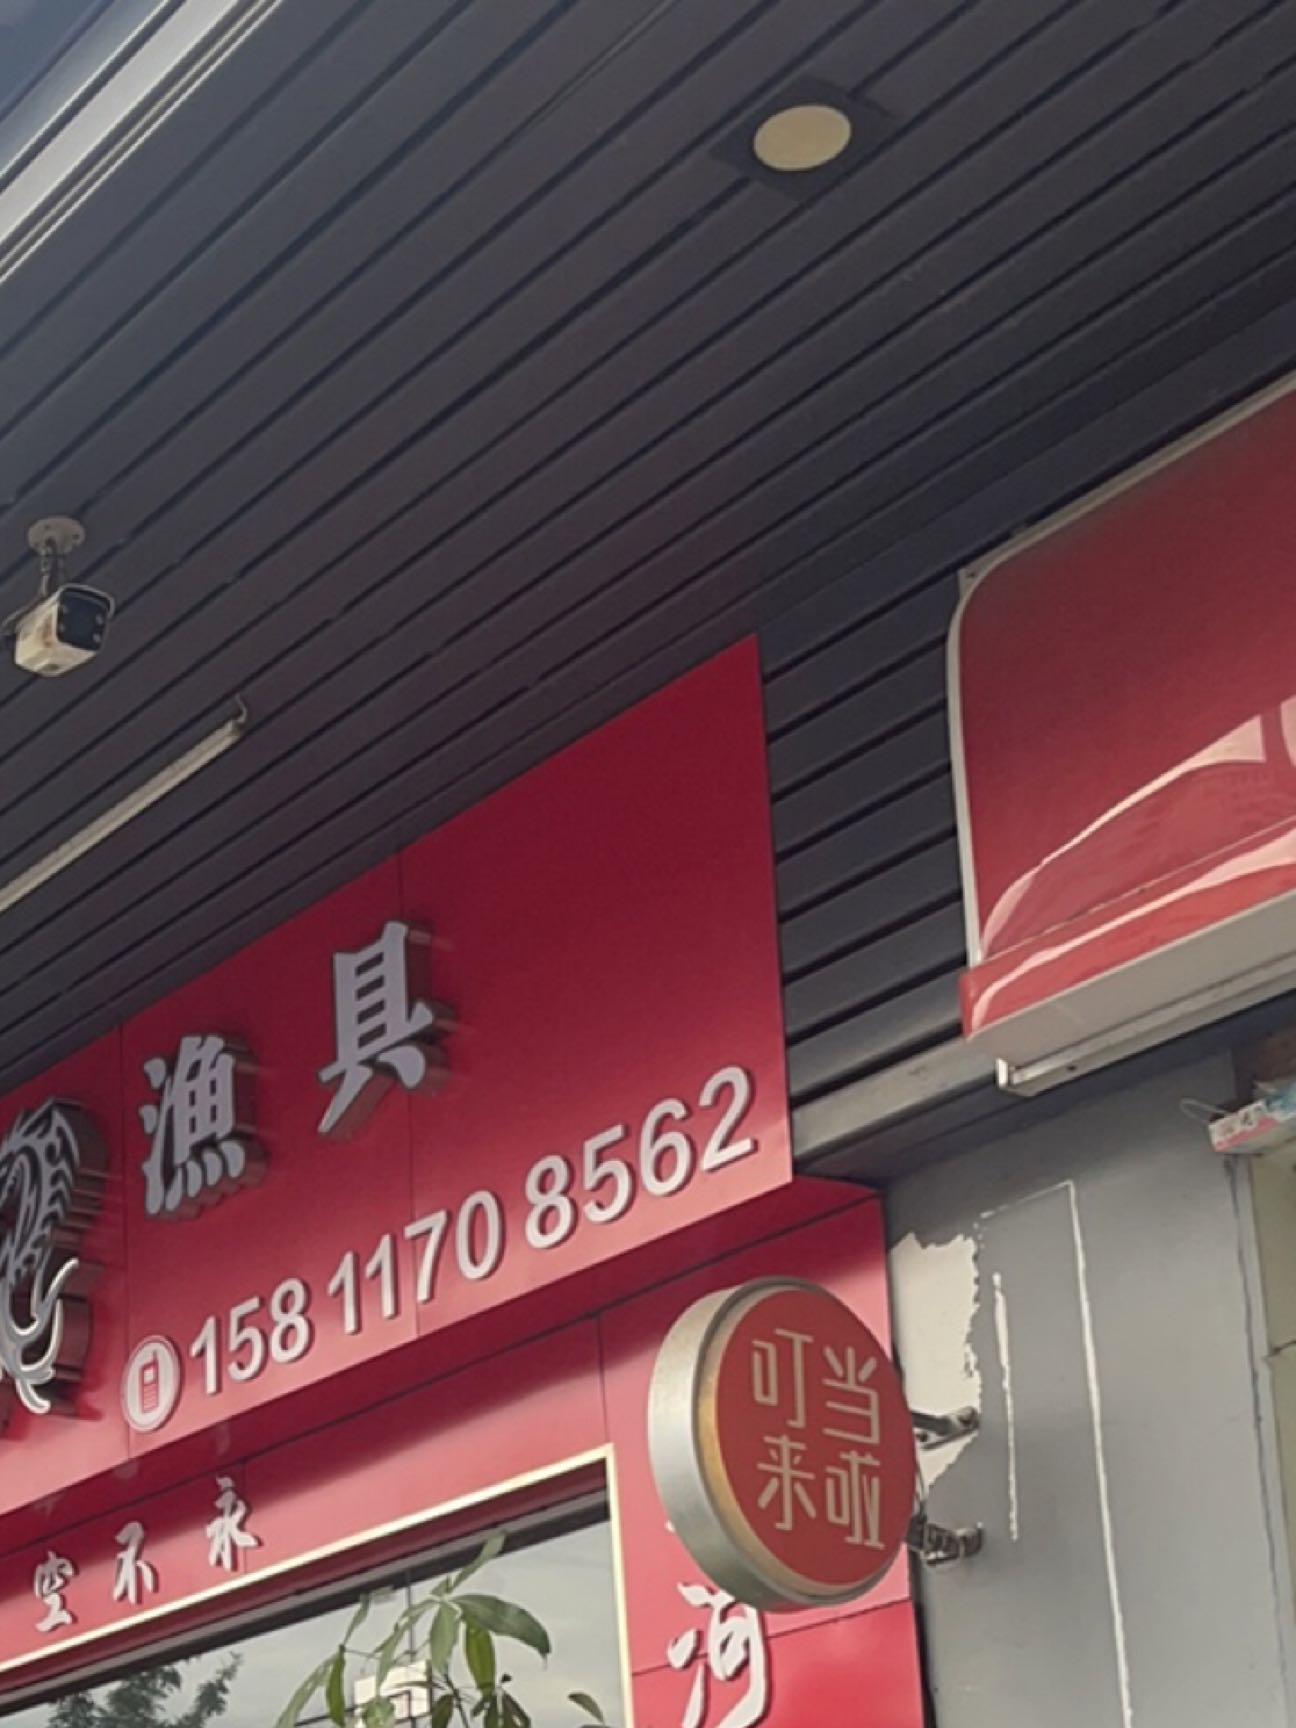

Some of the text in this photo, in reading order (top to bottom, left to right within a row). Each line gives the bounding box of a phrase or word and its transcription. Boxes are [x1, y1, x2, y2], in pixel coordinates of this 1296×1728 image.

[190, 1066, 756, 1397] 158 1170 8562
[750, 1326, 880, 1446] 叮当
